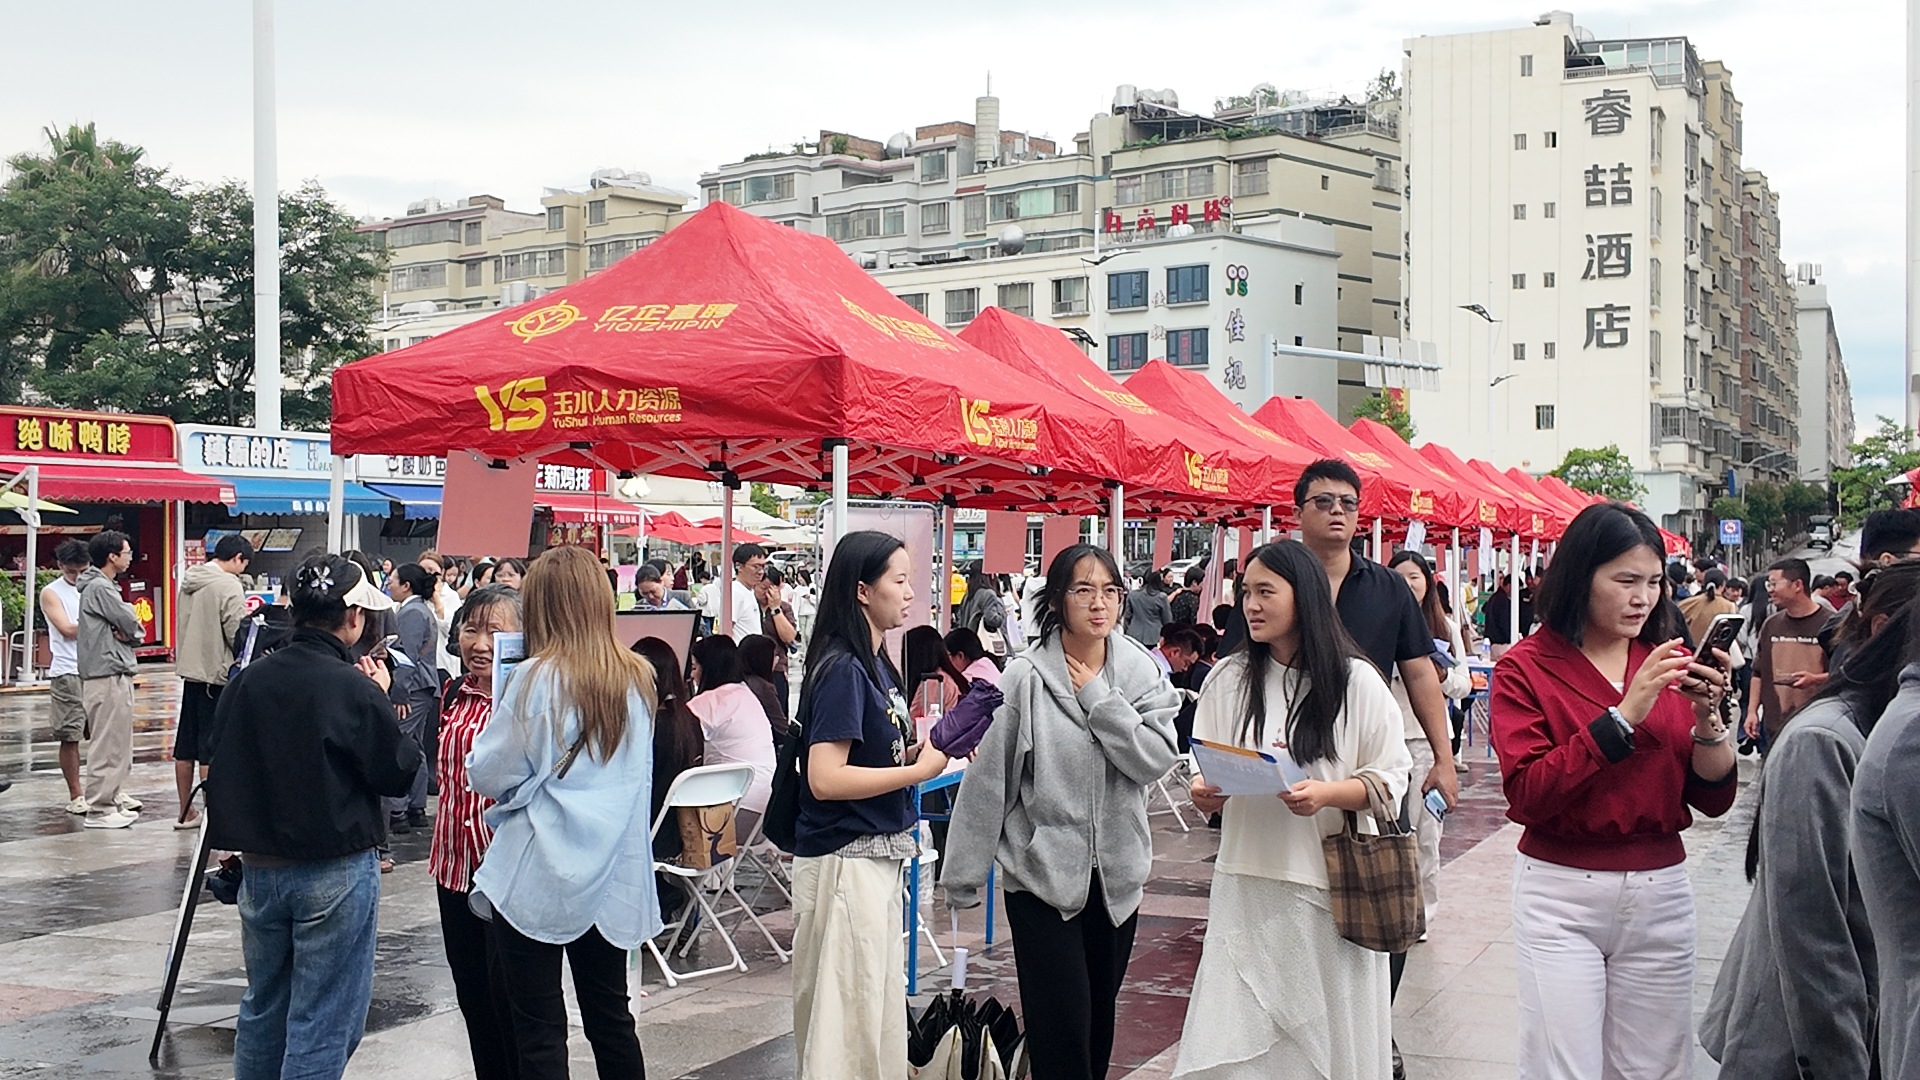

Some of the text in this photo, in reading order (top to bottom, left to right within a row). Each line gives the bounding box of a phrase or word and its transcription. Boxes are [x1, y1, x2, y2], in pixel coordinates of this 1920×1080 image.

[1582, 88, 1632, 349] 睿喆酒店
[1225, 280, 1249, 297] JS
[593, 318, 725, 333] YIQIZHIPIN
[599, 303, 739, 322] 亿企直聘
[1224, 308, 1247, 410] 佳视
[474, 376, 547, 432] YS
[553, 387, 683, 416] 玉水人力资源
[18, 417, 131, 455] 绝味鸭脖
[553, 413, 682, 429] YuShui Human Resources
[960, 398, 993, 446] YS
